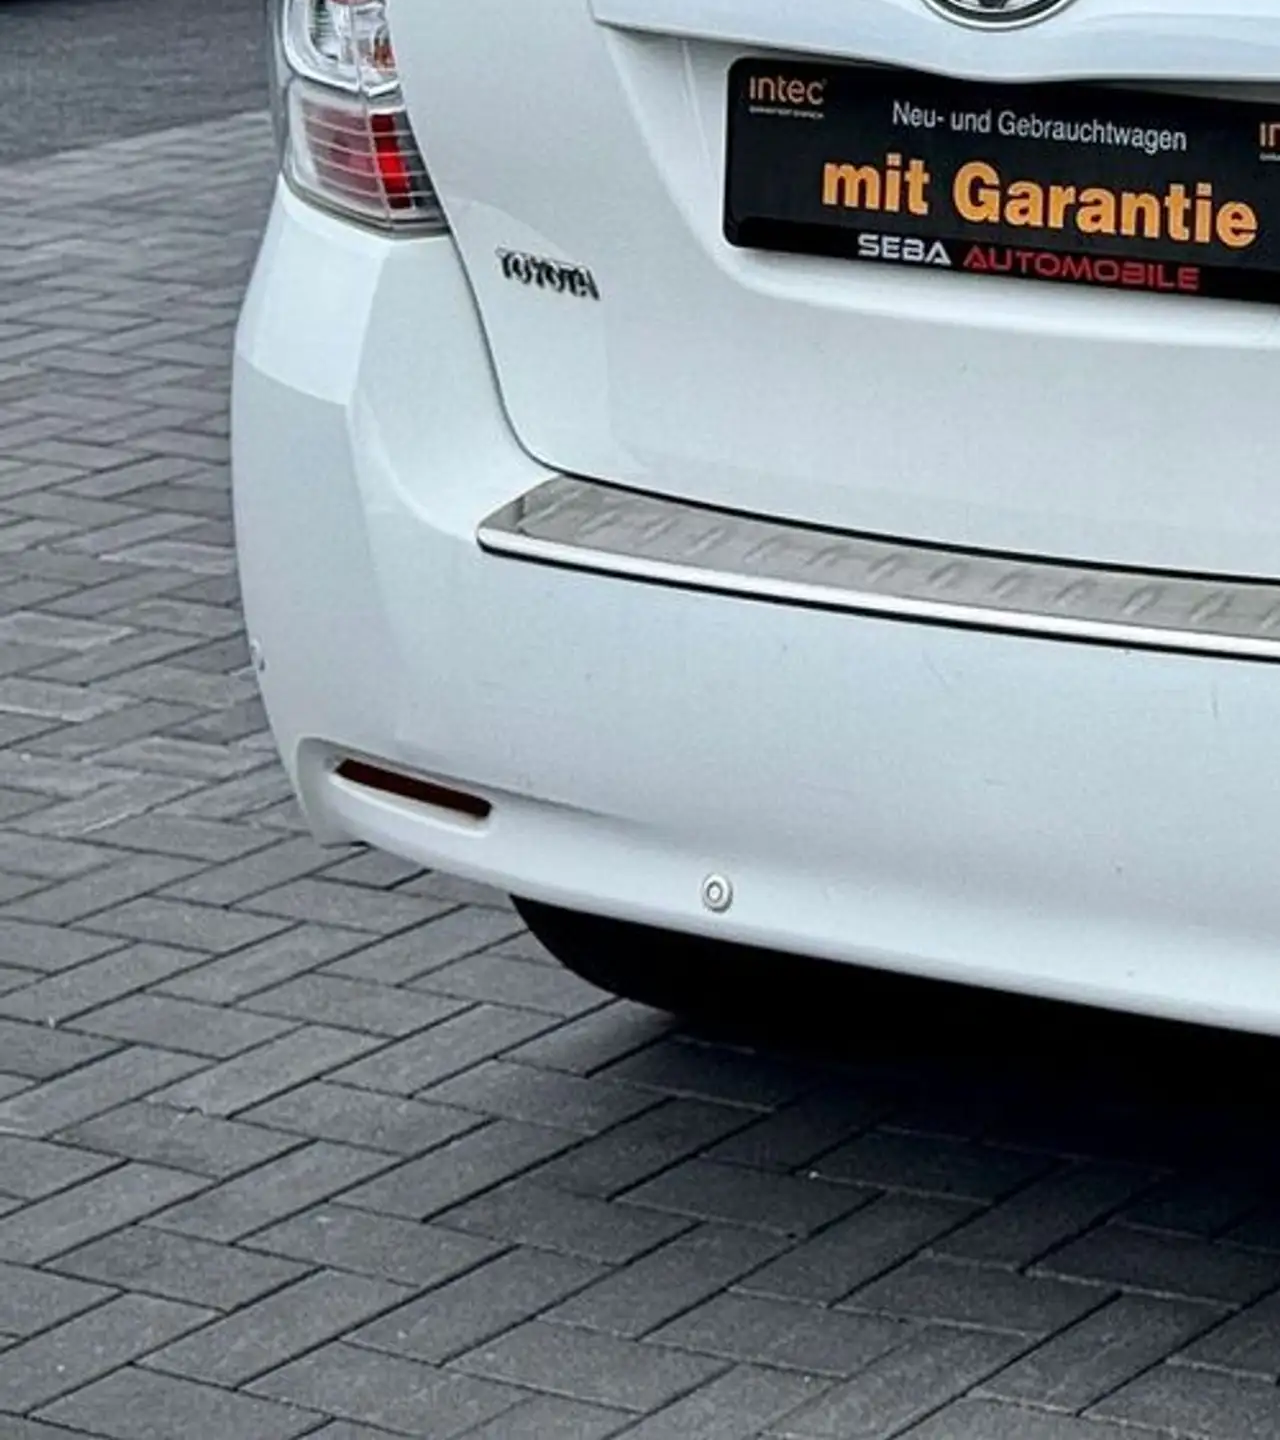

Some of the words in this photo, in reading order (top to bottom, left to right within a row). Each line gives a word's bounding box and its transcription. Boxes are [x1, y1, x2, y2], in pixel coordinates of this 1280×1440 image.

[749, 75, 824, 105] intec
[893, 101, 945, 129] Neu-
[951, 109, 991, 134] und
[997, 111, 1188, 153] Gebrauchtwagen
[822, 153, 928, 216] mit
[953, 161, 1258, 247] Garantie
[857, 234, 951, 266] SEBA
[963, 246, 1198, 290] AUTOMOBILE
